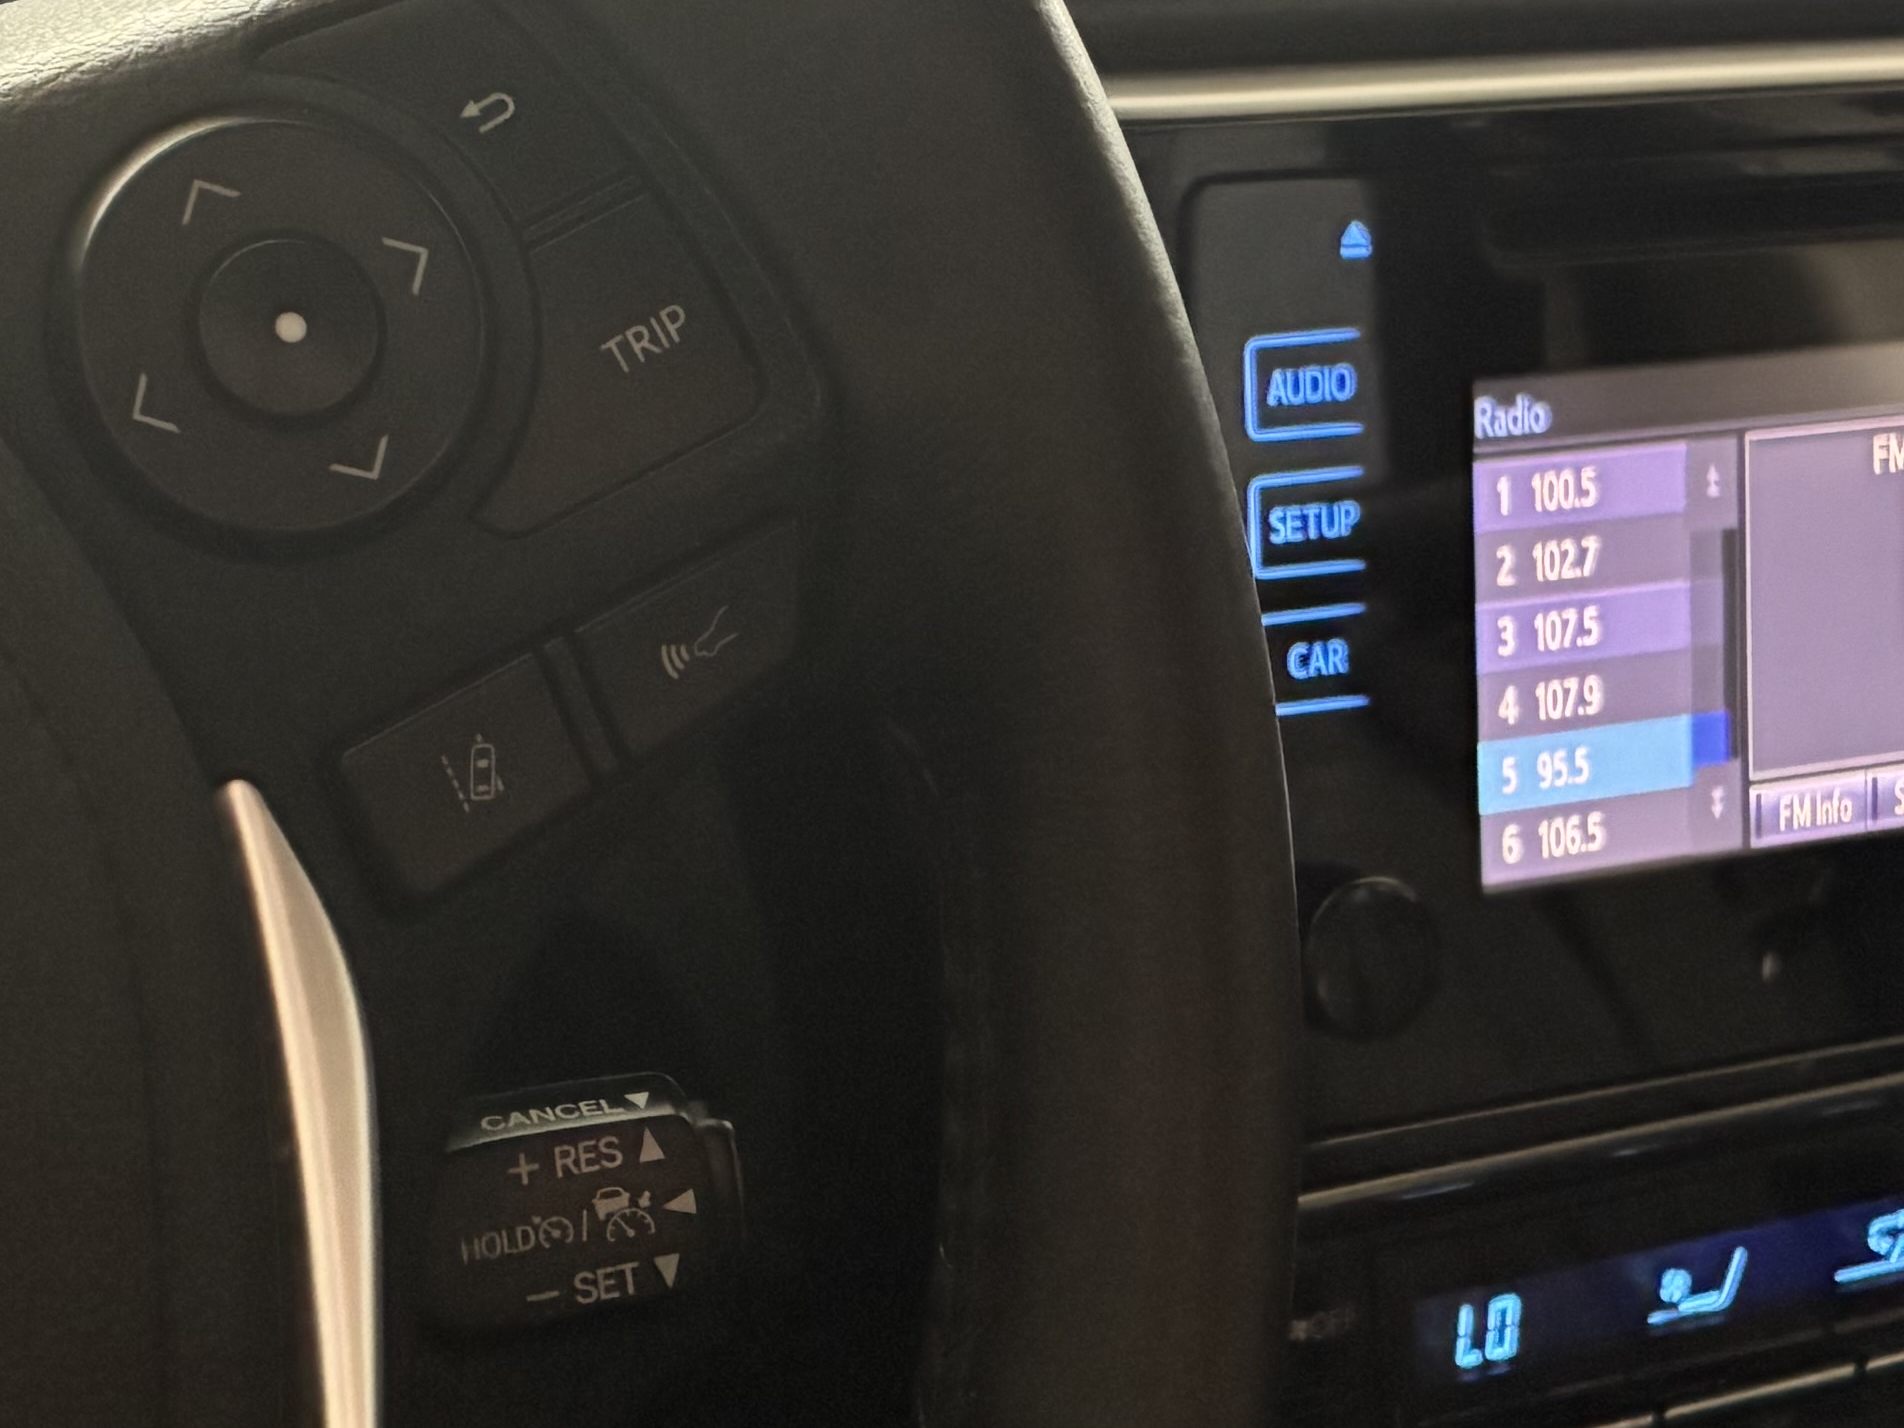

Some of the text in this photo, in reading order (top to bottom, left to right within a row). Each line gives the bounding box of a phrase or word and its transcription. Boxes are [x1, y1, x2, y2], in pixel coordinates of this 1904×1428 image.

[600, 304, 686, 373] TRIP
[1265, 363, 1356, 408] AUDIO
[1473, 392, 1553, 440] Radio
[1496, 465, 1600, 517] 1 100.5
[1268, 500, 1361, 545] SETUP
[1496, 534, 1602, 587] 2 102.7
[1497, 604, 1603, 657] 3 107.5
[1286, 637, 1350, 680] CAR
[1498, 674, 1605, 725] 4 107.9
[1501, 745, 1591, 795] 5 95.5
[1778, 786, 1853, 832] FM Info
[1501, 811, 1607, 865] 6 106.5
[480, 1098, 626, 1132] CANCEL
[553, 1134, 624, 1178] RES
[460, 1225, 537, 1265] HOLD
[573, 1260, 641, 1305] SET
